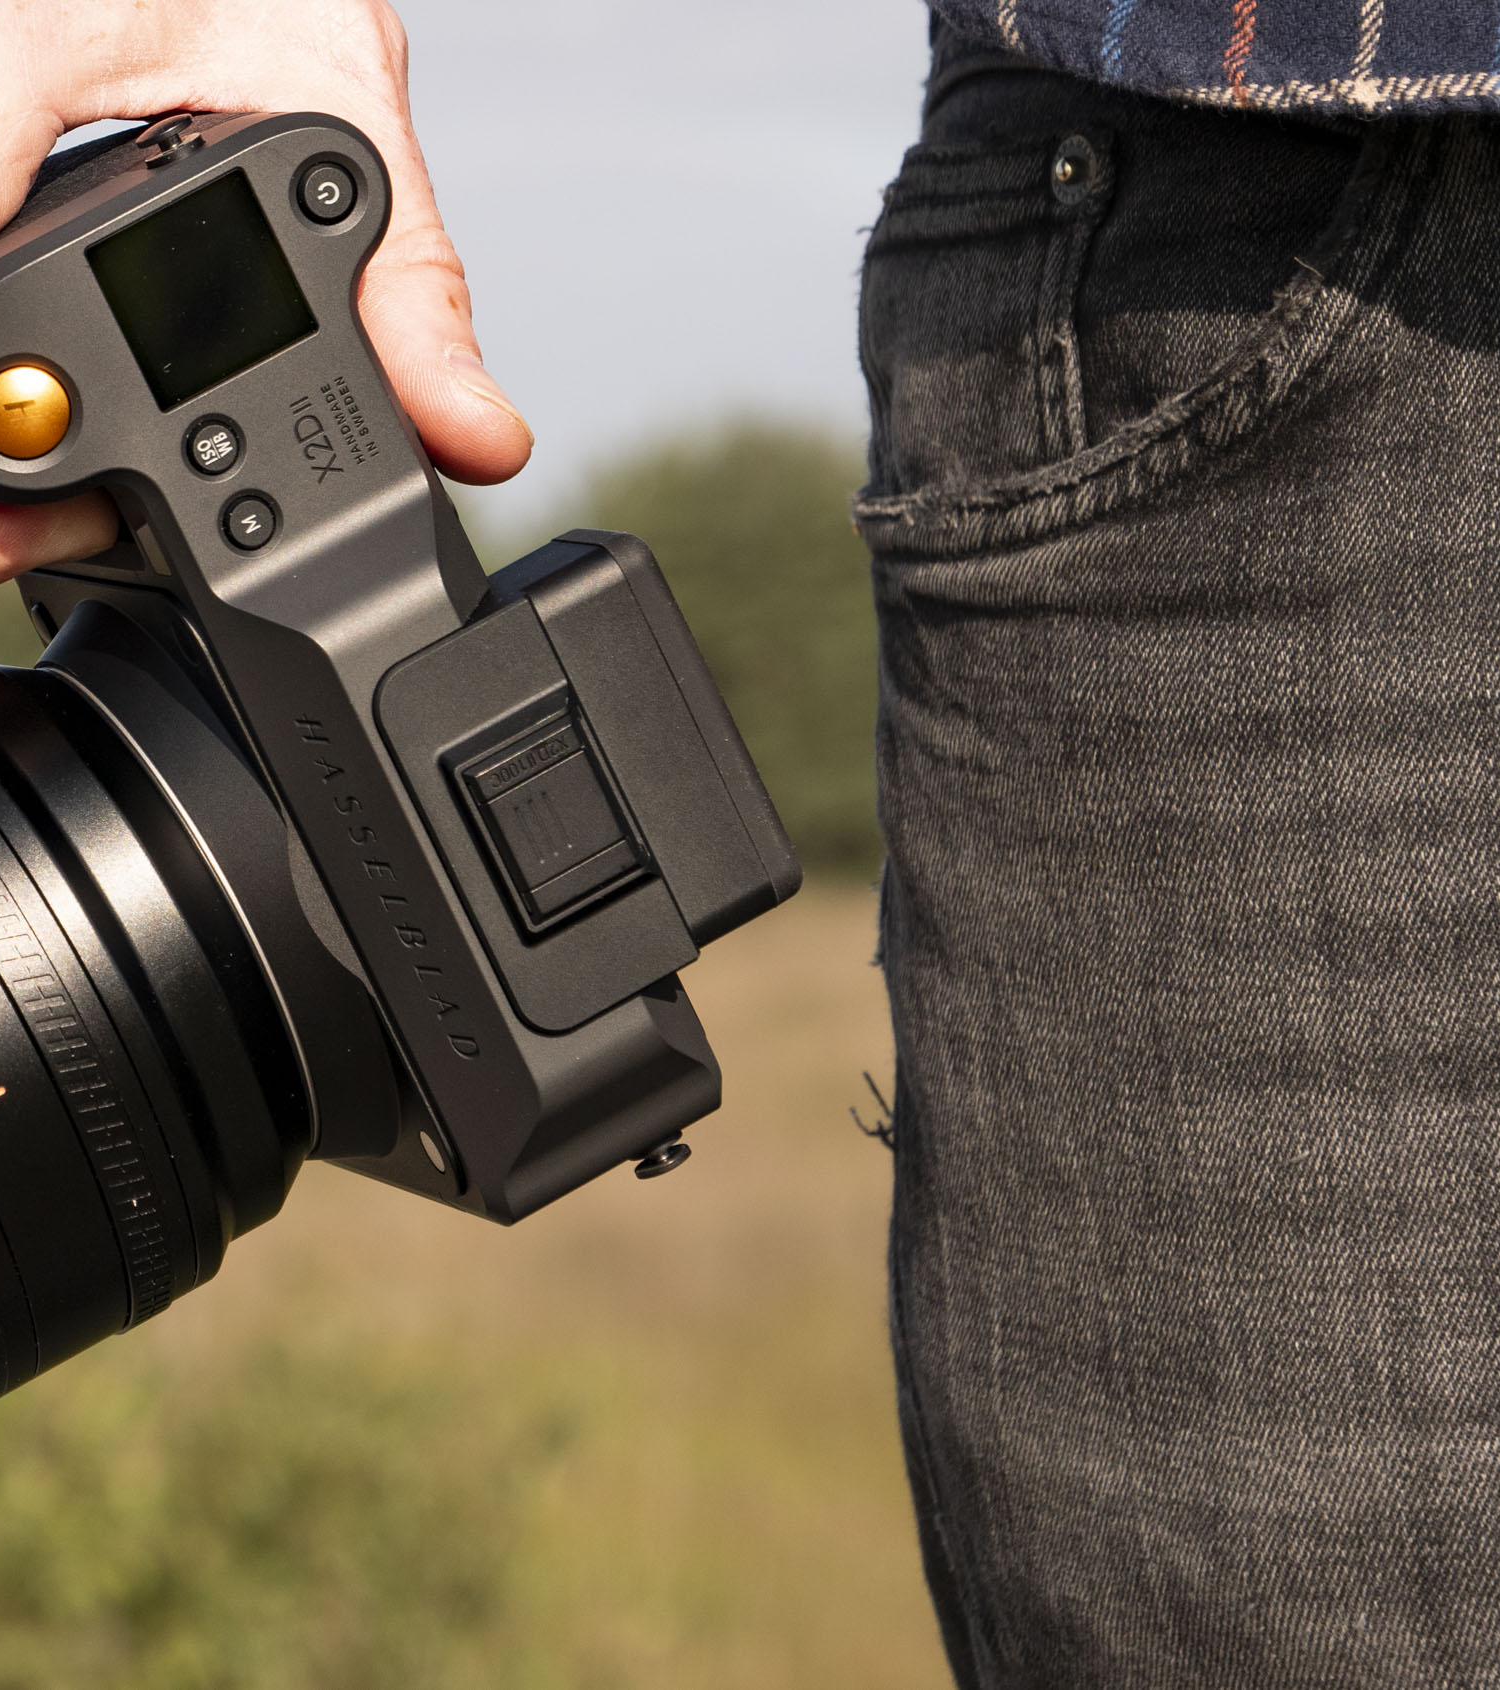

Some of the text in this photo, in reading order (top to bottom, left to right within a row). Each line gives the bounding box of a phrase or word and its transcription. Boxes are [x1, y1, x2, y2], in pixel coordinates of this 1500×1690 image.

[320, 384, 366, 465] HANDMADE
[334, 376, 380, 458] IN SWEDEN
[197, 439, 220, 466] ISO
[213, 431, 234, 458] WB
[240, 514, 262, 534] M
[295, 713, 480, 1061] HASSELBLAD
